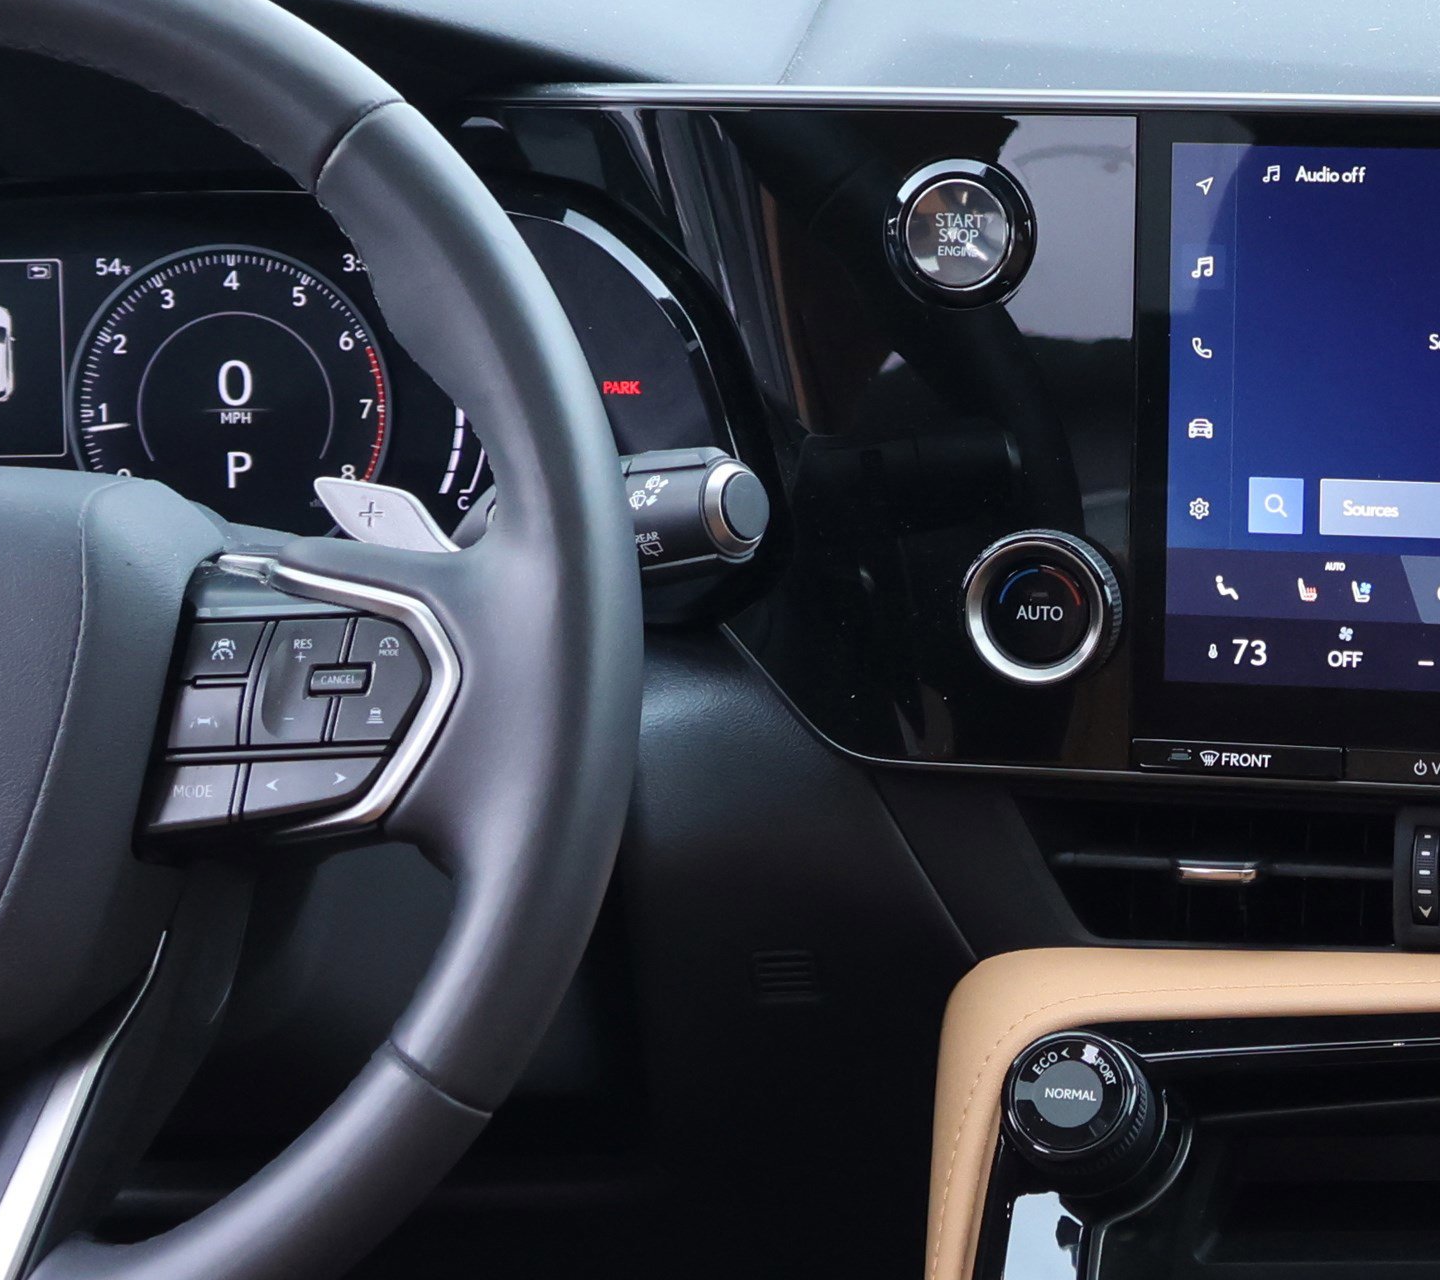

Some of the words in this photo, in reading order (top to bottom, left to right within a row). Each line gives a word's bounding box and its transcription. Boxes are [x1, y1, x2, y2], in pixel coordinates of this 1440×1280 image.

[1295, 166, 1339, 185] Audio
[1341, 166, 1366, 184] off
[935, 213, 984, 228] START
[938, 228, 979, 243] STOP
[937, 246, 979, 258] ENGINE
[342, 254, 366, 271] 3:
[223, 271, 240, 291] 4
[161, 289, 175, 309] 3
[292, 287, 307, 307] 5
[113, 334, 127, 354] 2
[339, 331, 354, 351] 6
[218, 360, 252, 406] 0
[603, 381, 641, 395] PARK
[98, 403, 108, 422] 1
[220, 412, 252, 424] MPH
[360, 399, 373, 419] 7
[227, 452, 252, 488] P
[457, 497, 469, 510] C
[1343, 500, 1399, 518] Sources
[1325, 561, 1346, 572] AUTO
[1016, 605, 1063, 623] AUTO
[293, 639, 313, 650] RES
[379, 649, 400, 657] MODE
[1232, 638, 1268, 666] 73
[1327, 650, 1363, 668] OFF
[320, 675, 356, 685] CANCEL
[1221, 752, 1271, 770] FRONT
[173, 784, 213, 798] MODE
[1032, 1051, 1058, 1076] ECO
[1044, 1088, 1097, 1101] NORMAL
